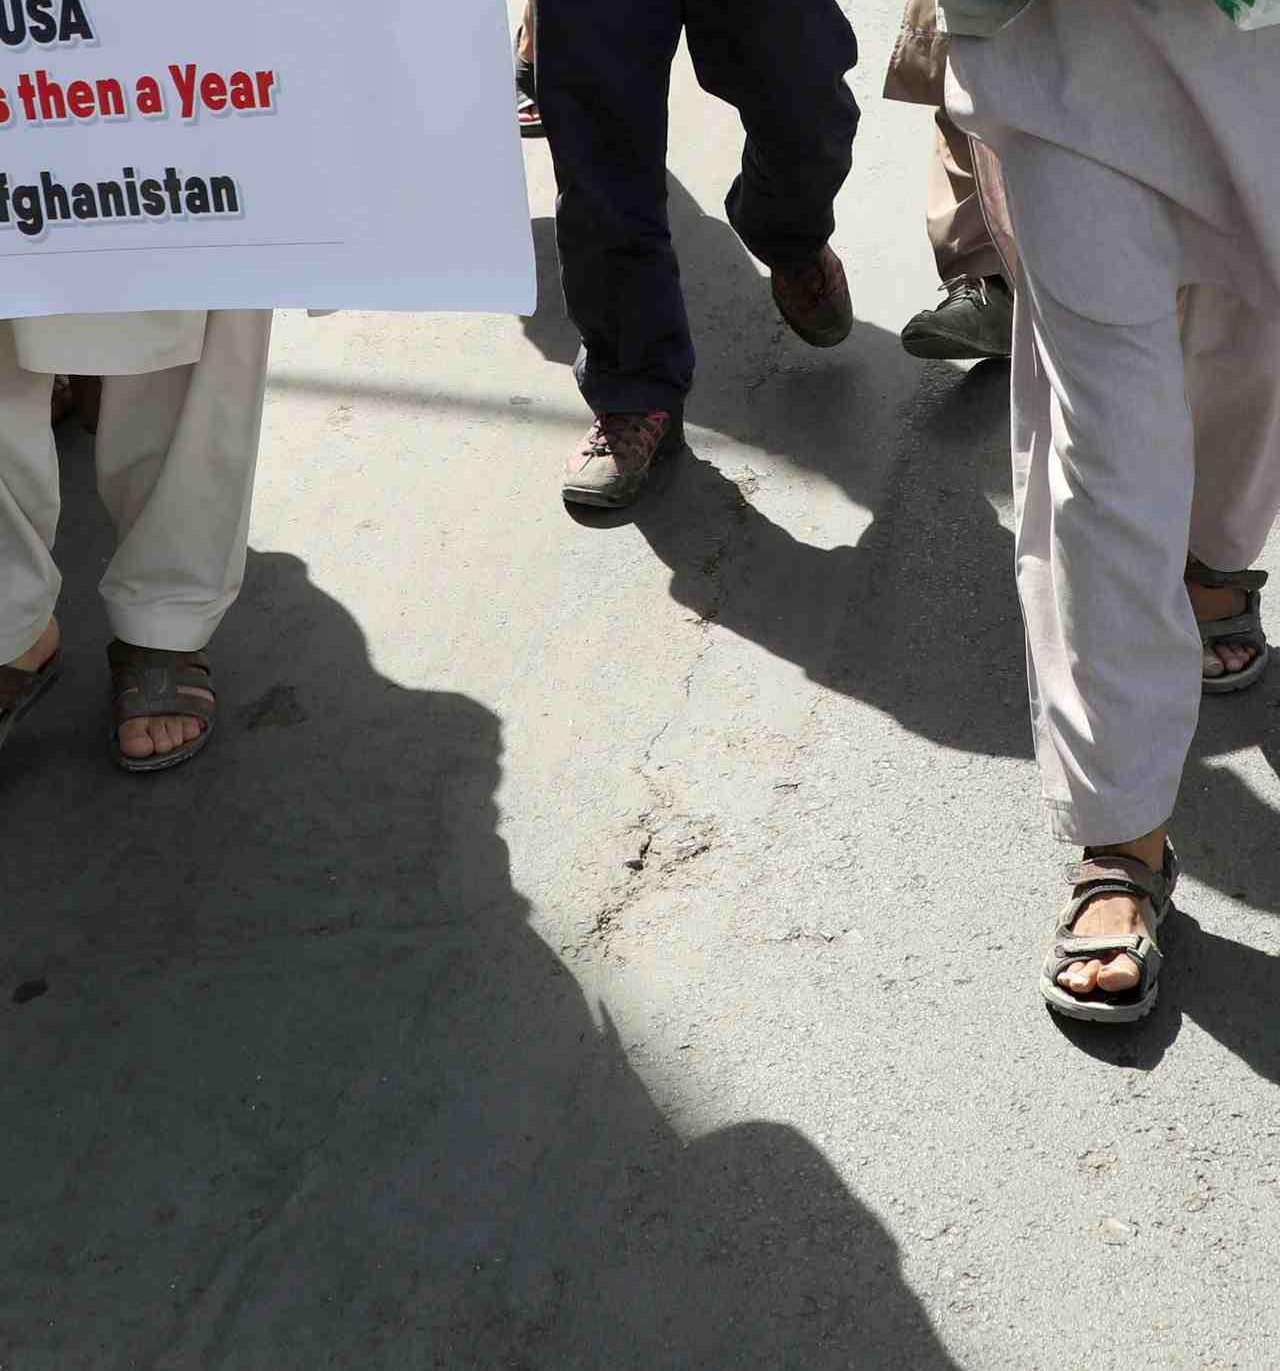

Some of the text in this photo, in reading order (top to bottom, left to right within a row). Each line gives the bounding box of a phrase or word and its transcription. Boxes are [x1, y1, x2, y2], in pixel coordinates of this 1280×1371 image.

[19, 70, 124, 118] then
[138, 77, 161, 113] a
[170, 63, 274, 117] Year
